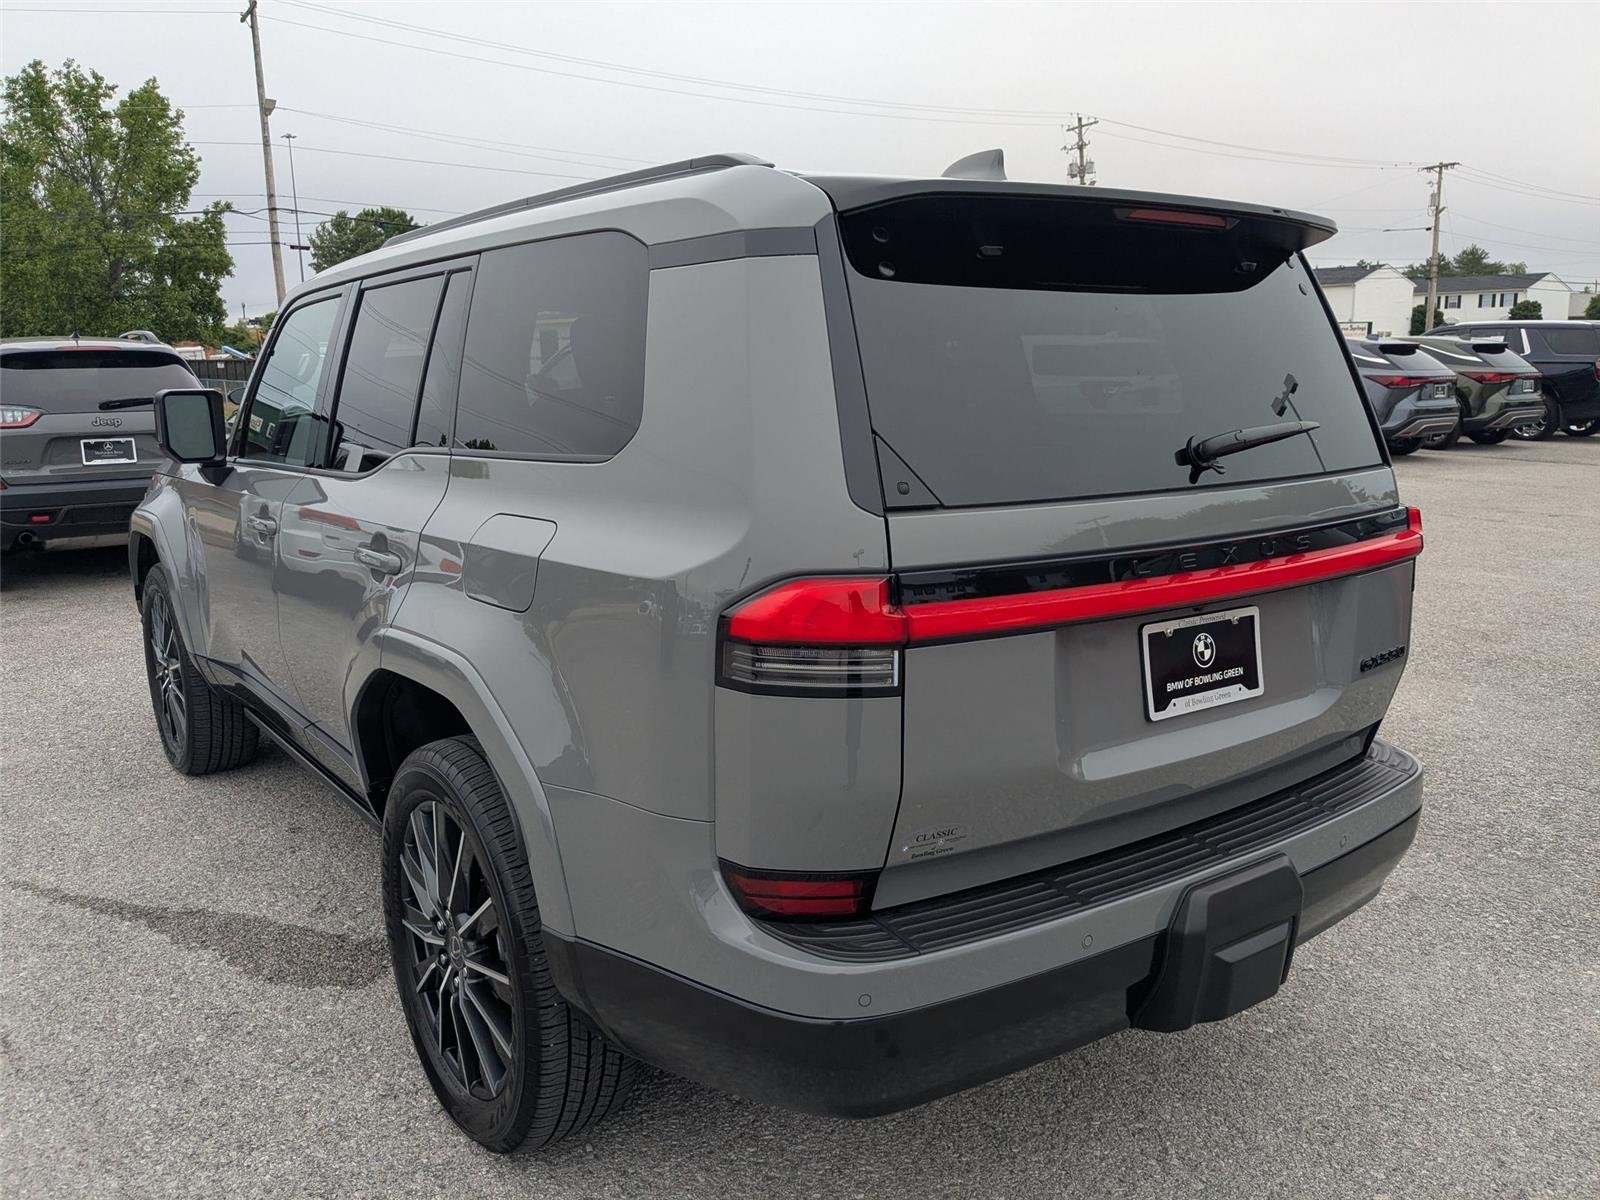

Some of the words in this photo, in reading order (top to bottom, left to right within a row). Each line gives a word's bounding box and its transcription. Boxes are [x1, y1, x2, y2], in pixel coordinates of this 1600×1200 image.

[92, 417, 122, 427] Jeep
[1132, 535, 1310, 574] LEXUS
[1166, 679, 1184, 692] BMW
[1184, 677, 1194, 688] OF
[1194, 671, 1223, 686] BOWLING
[1223, 666, 1244, 679] GREEN
[1214, 691, 1231, 701] Green
[915, 827, 958, 842] CLASSIC
